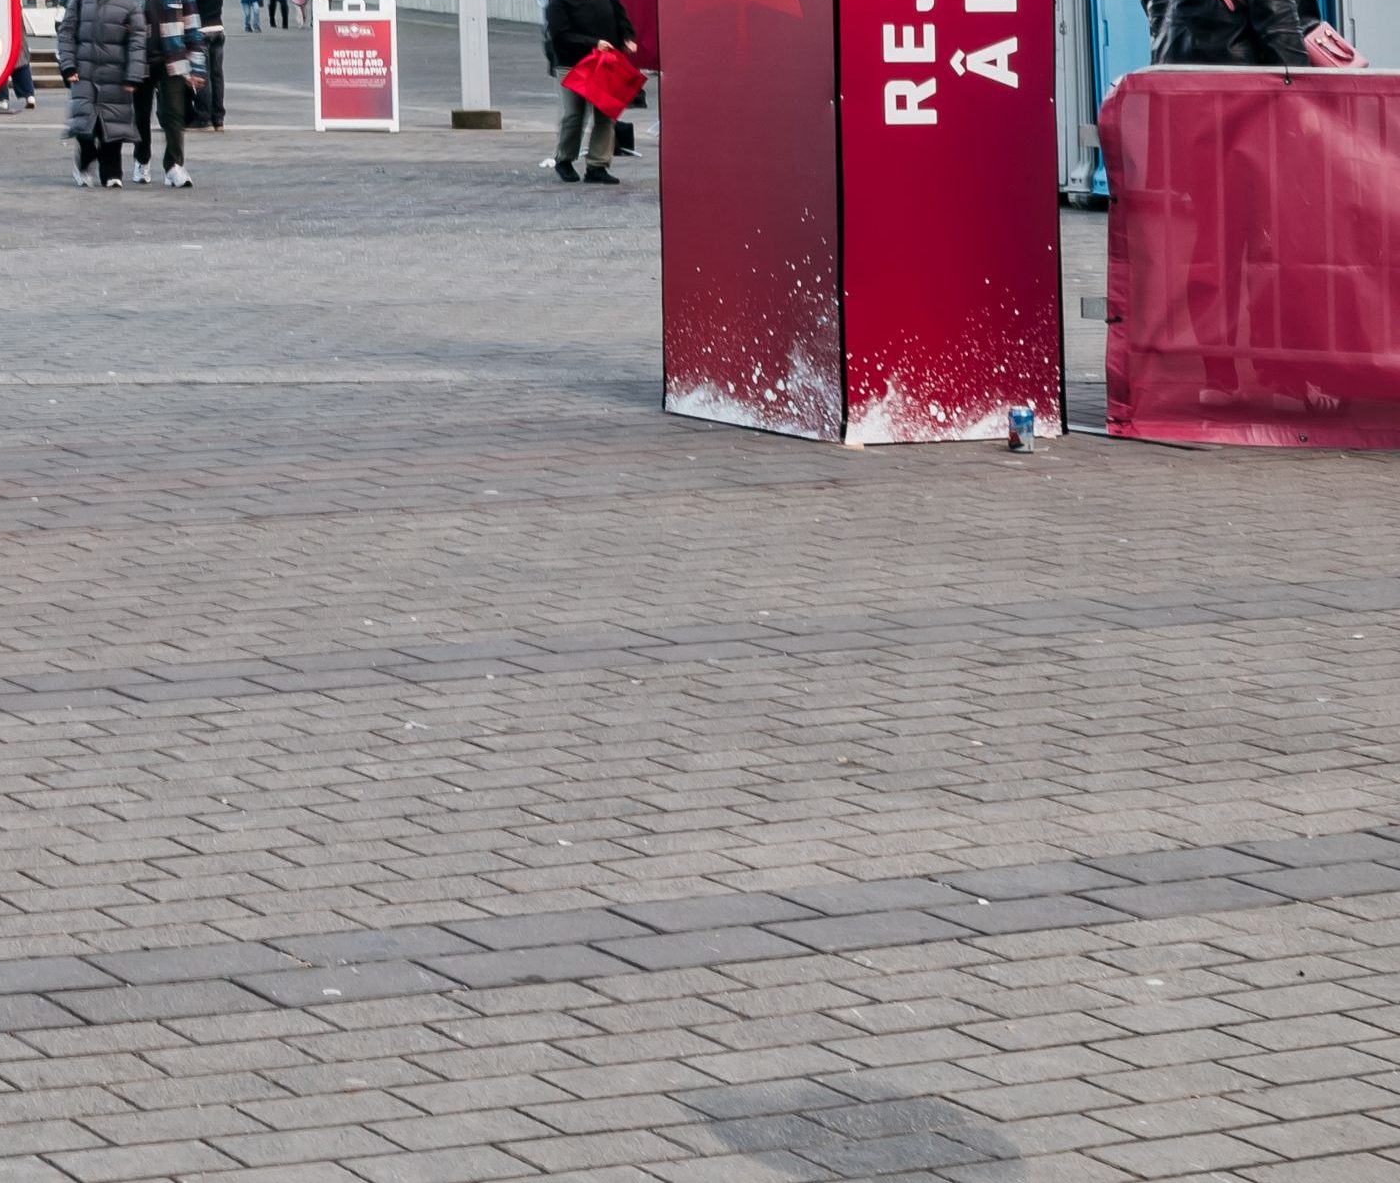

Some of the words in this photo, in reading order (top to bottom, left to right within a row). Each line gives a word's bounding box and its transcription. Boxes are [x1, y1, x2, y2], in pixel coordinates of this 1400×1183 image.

[333, 49, 364, 58] NOTICE
[366, 49, 378, 58] OF
[328, 58, 363, 67] FILMING
[364, 58, 384, 67] AND
[949, 35, 1019, 89] Â
[324, 66, 388, 76] PHOTOGRAPHY
